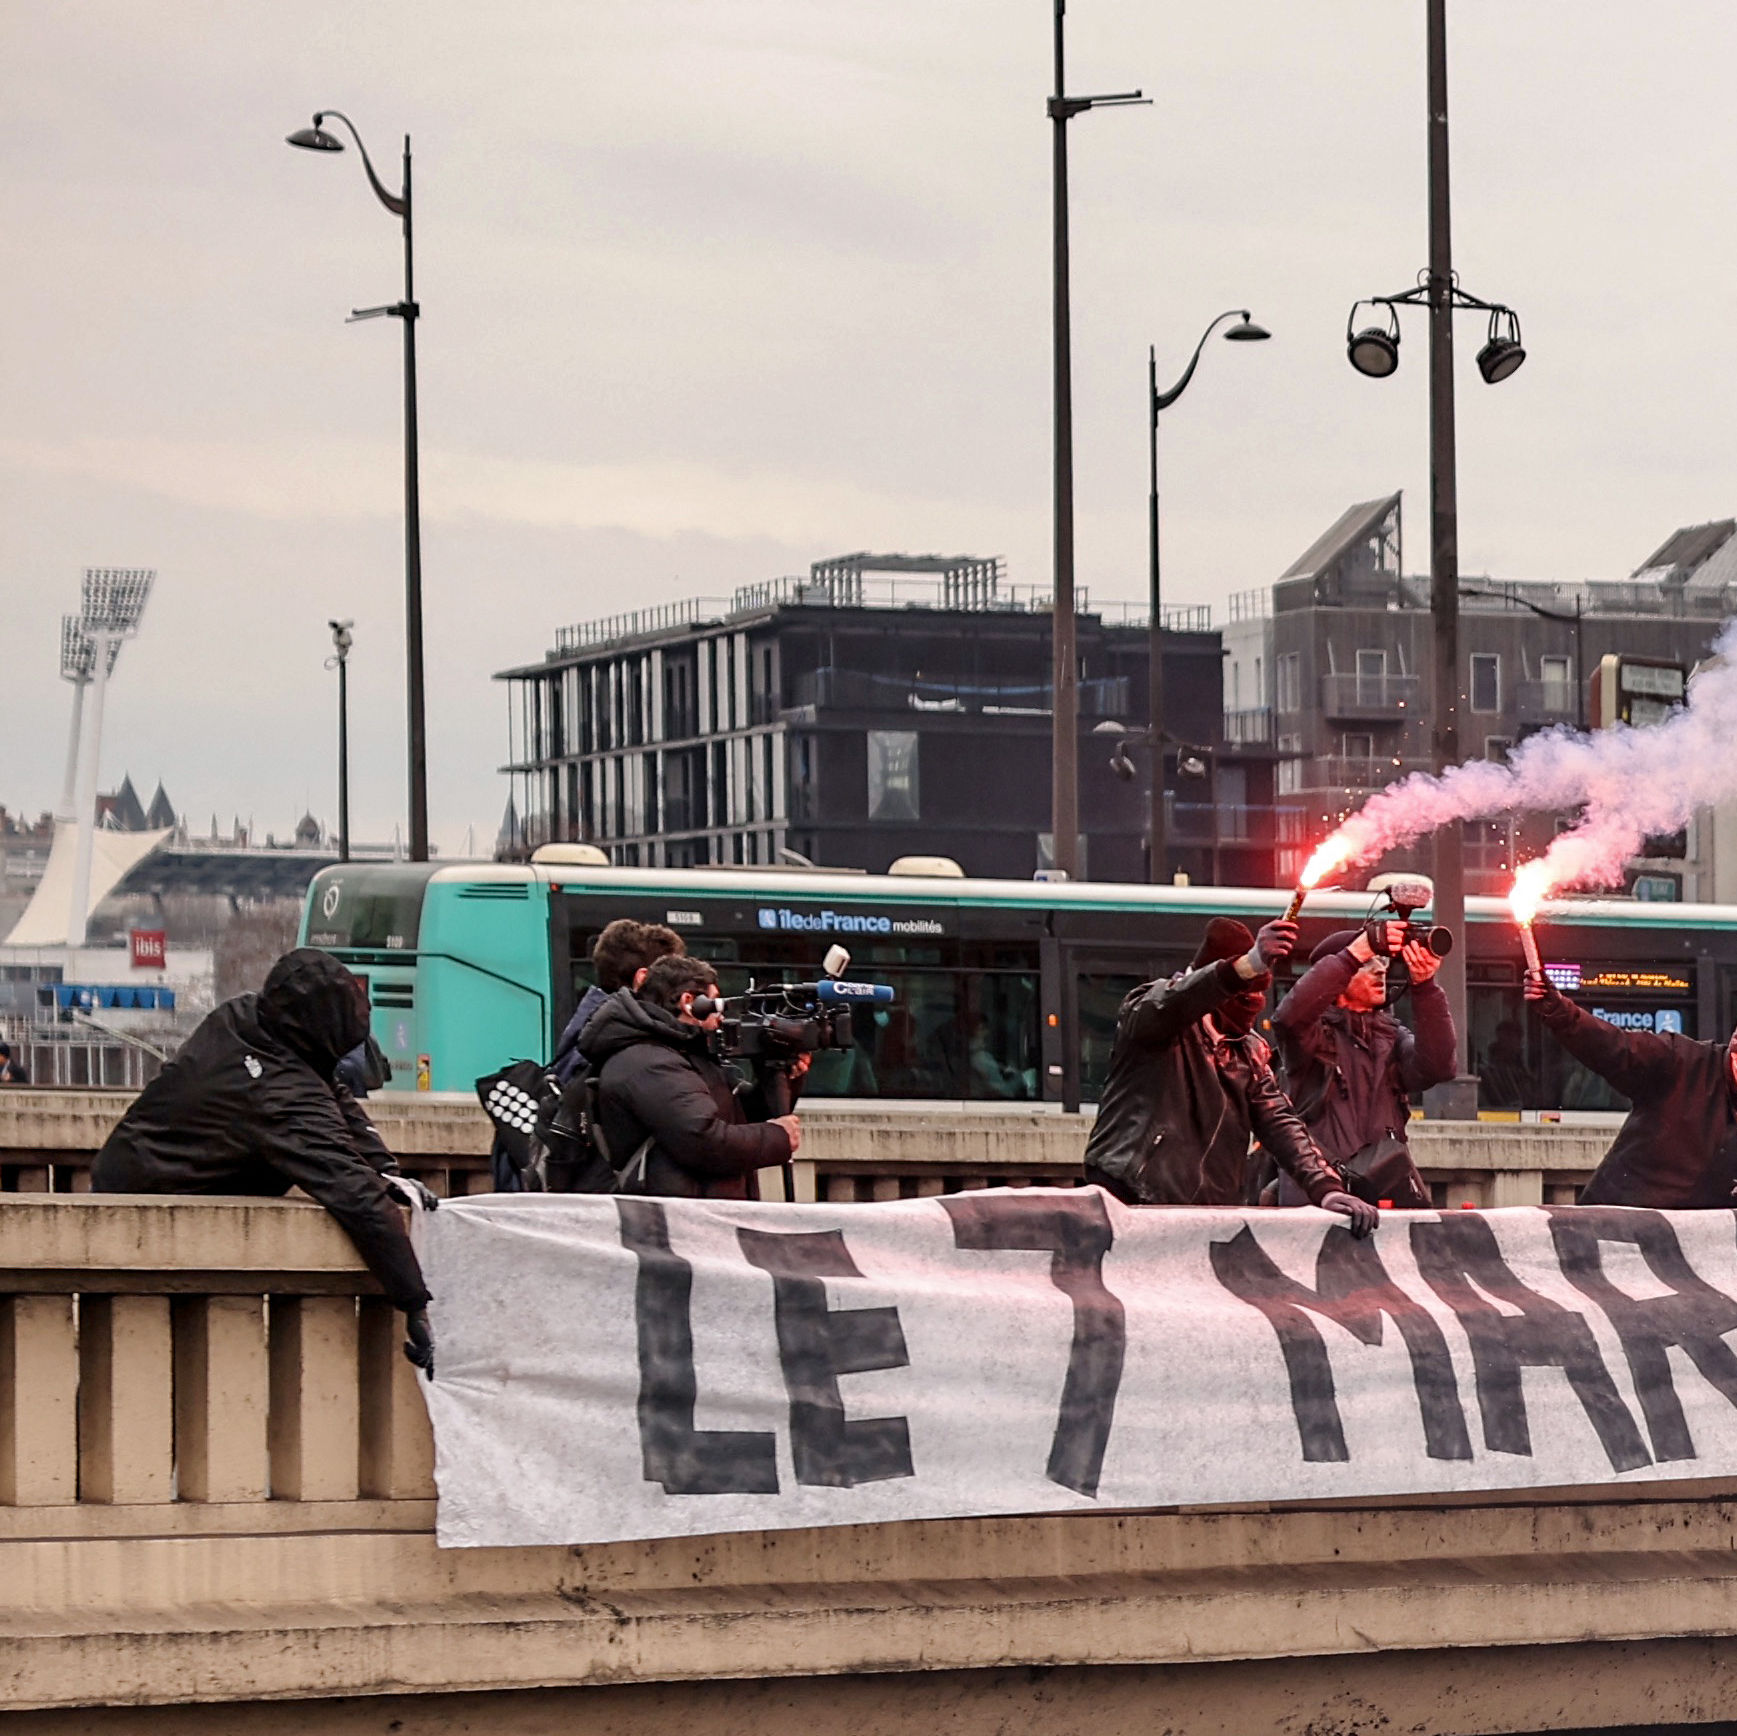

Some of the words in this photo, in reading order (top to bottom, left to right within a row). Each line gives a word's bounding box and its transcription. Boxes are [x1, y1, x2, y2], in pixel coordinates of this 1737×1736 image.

[893, 919, 942, 935] mobilités
[135, 936, 161, 957] ibis
[614, 1198, 914, 1496] LE
[936, 1193, 1126, 1499] 7
